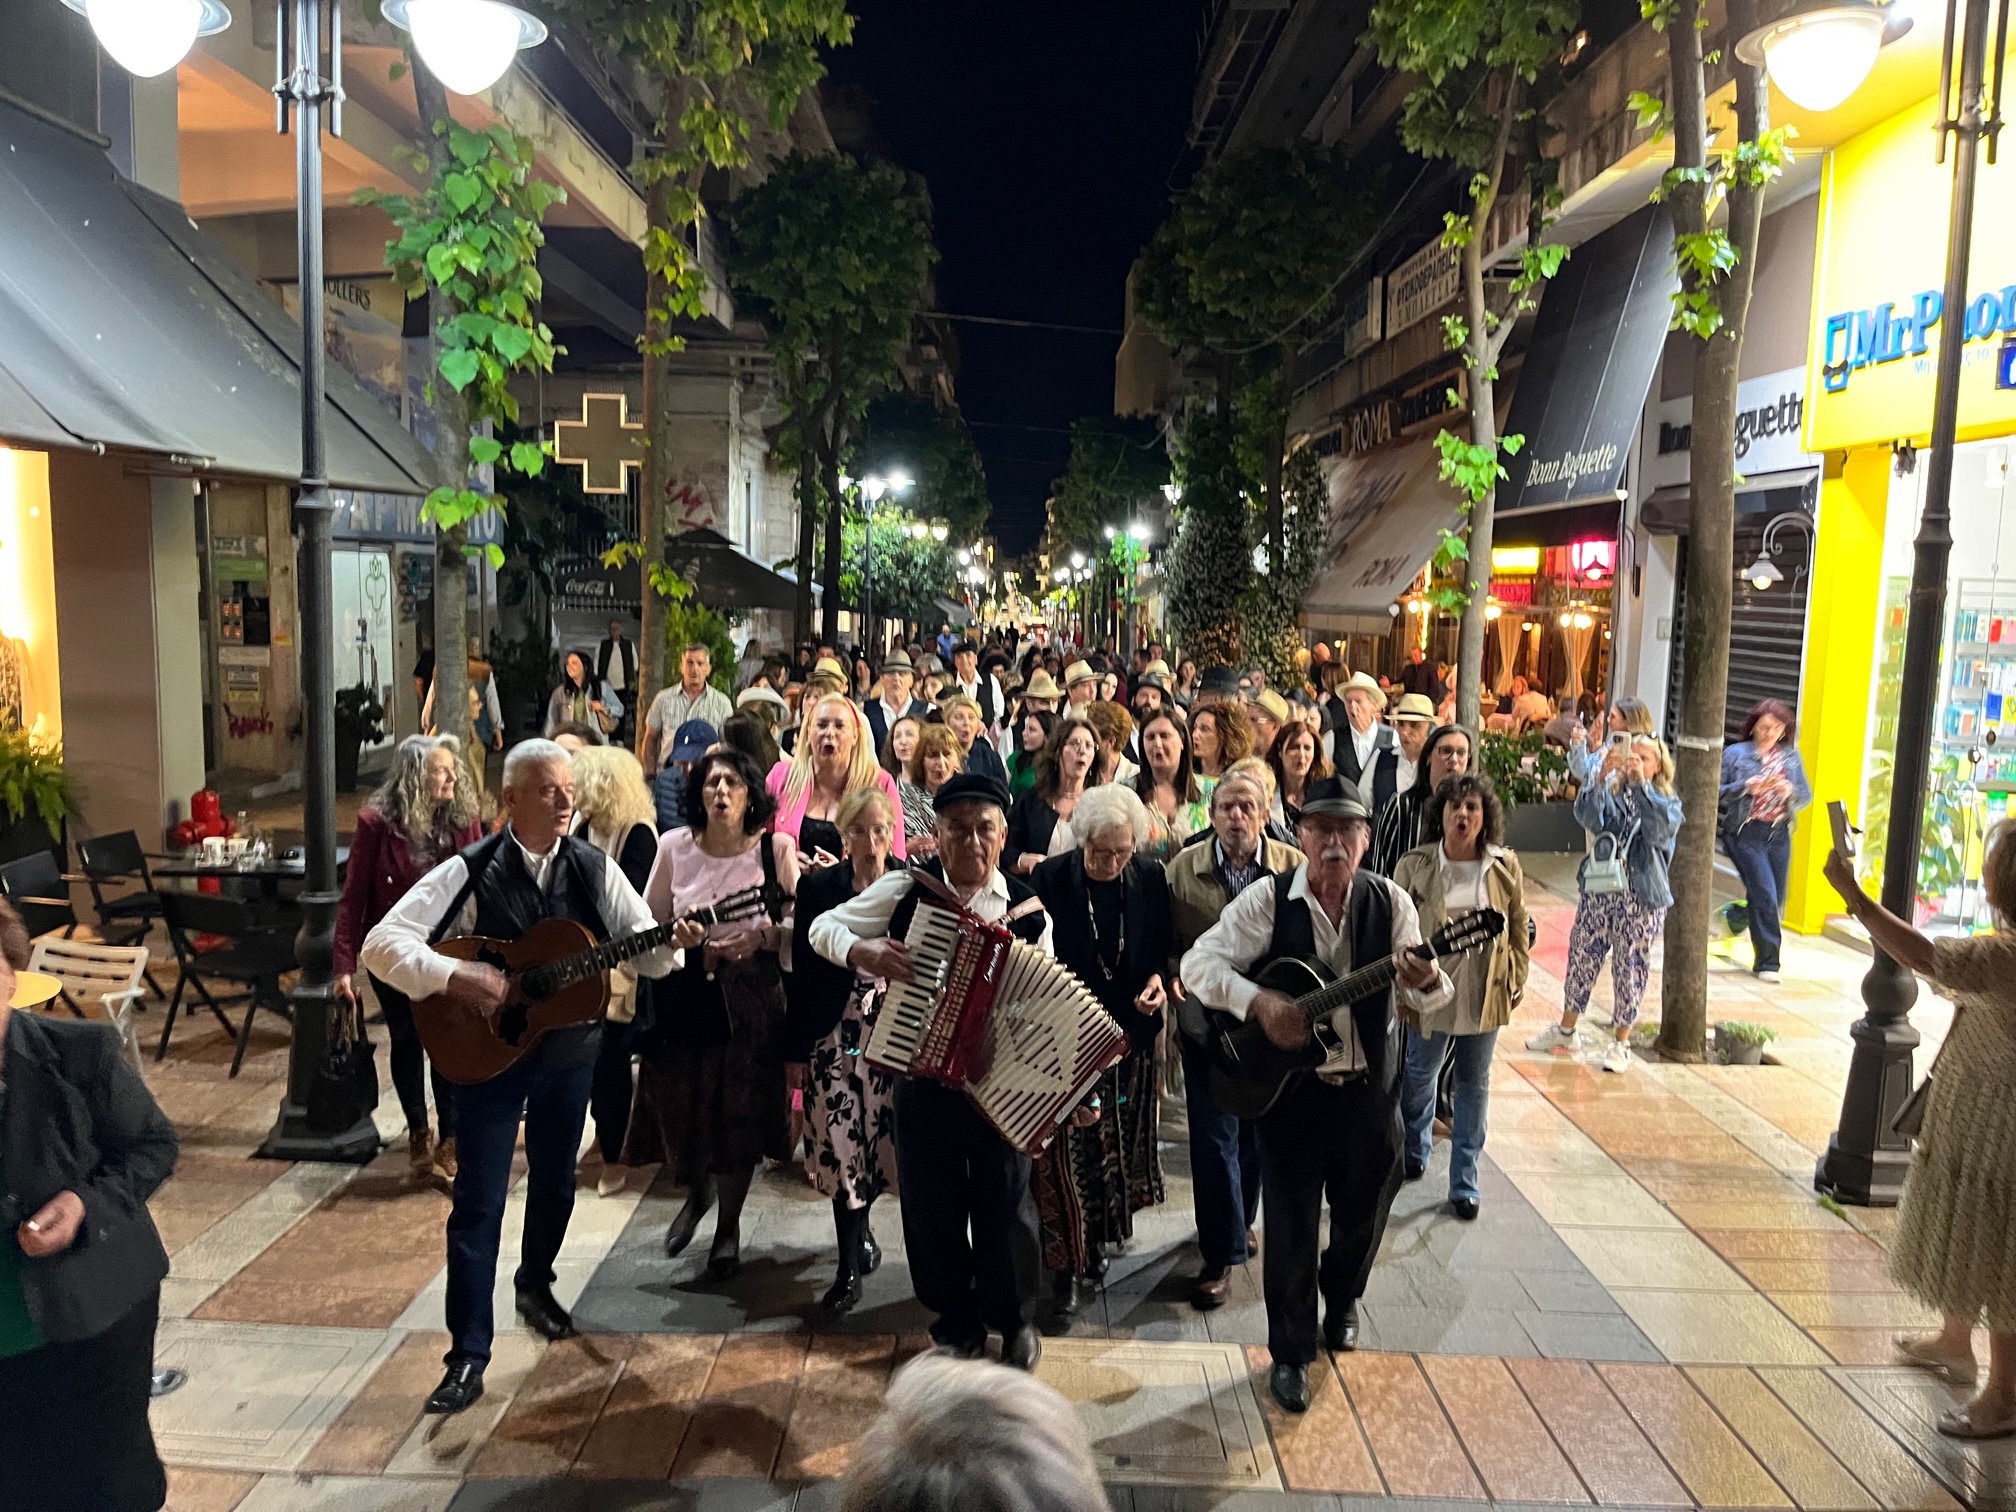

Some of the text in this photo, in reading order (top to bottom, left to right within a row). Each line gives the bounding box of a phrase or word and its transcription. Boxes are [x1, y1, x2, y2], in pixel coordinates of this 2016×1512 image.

[1352, 400, 1392, 453] ROMA
[1658, 391, 1804, 460] Bon guett
[1526, 442, 1617, 489] Bonn Baguette
